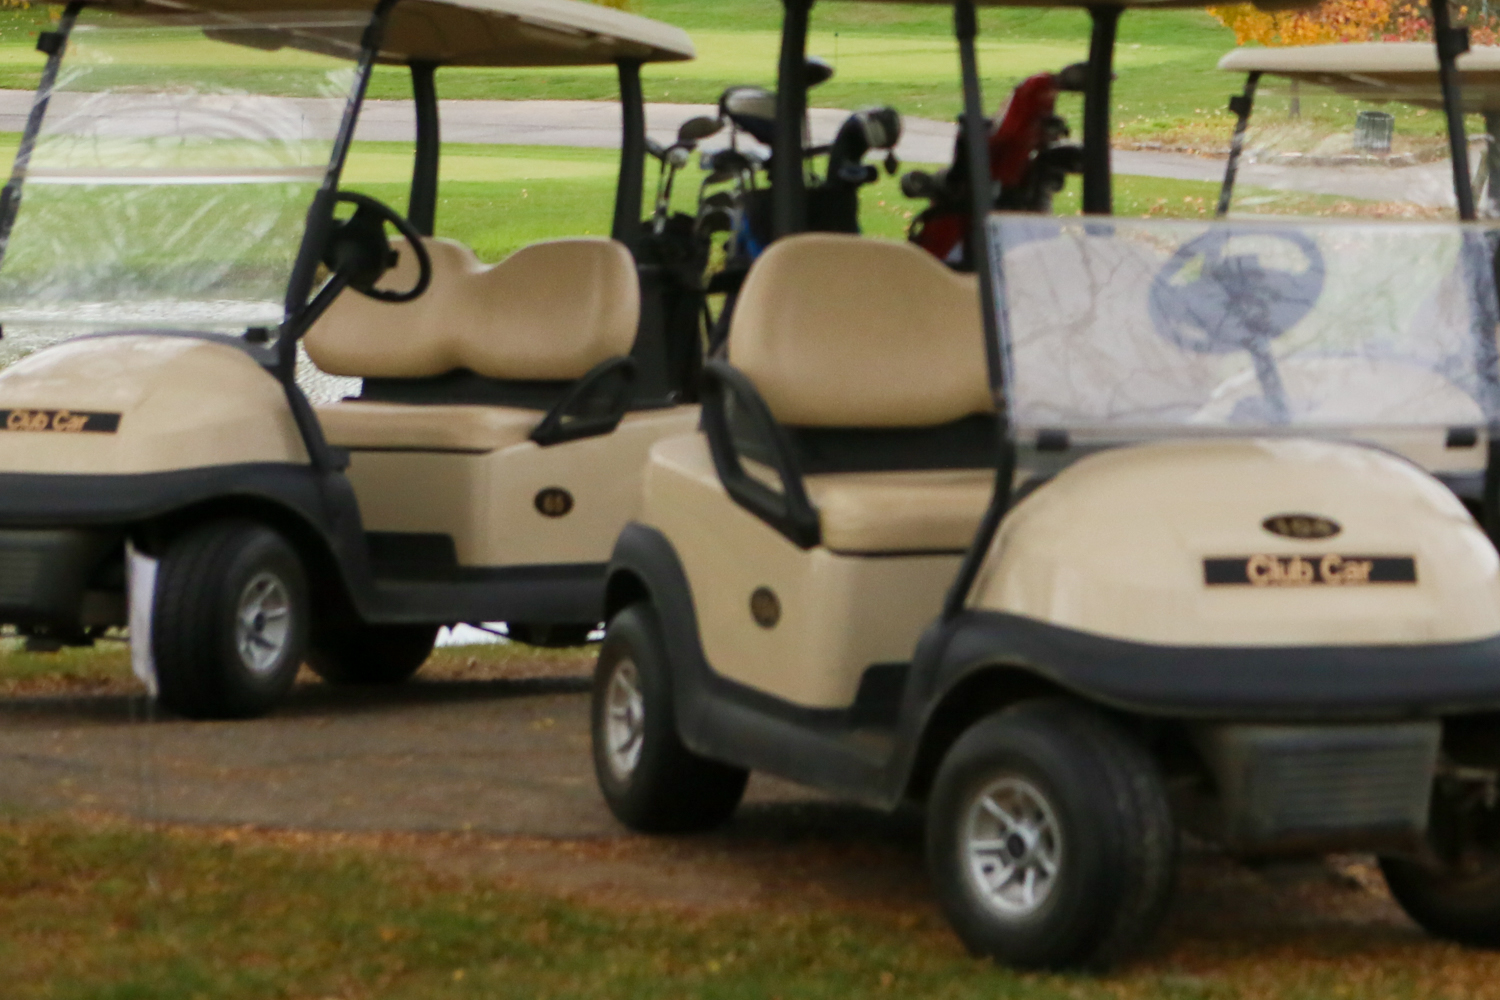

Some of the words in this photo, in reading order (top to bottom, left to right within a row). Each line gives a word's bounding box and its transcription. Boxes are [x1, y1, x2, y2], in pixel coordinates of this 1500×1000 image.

[7, 409, 49, 432] Club
[52, 409, 90, 432] Car
[1246, 554, 1315, 585] Club
[1320, 554, 1374, 585] Car
